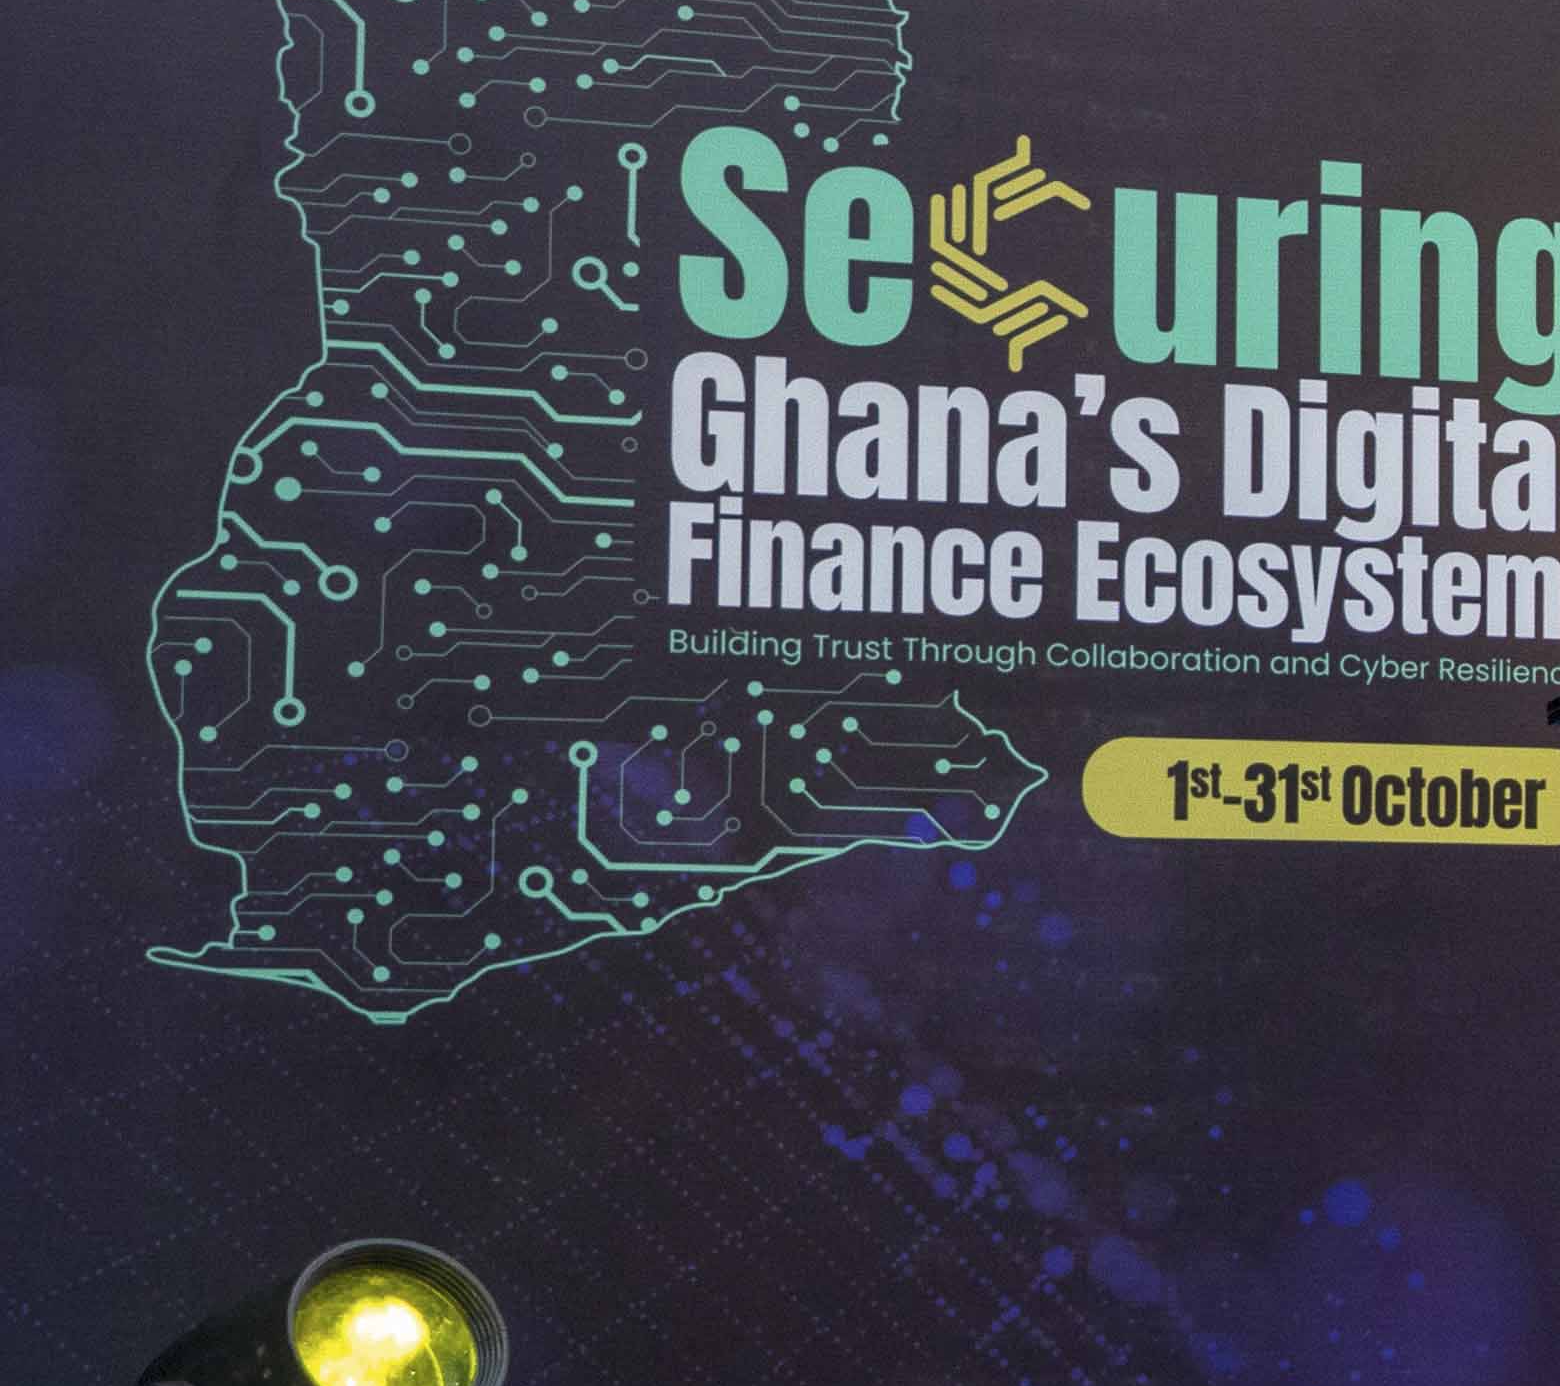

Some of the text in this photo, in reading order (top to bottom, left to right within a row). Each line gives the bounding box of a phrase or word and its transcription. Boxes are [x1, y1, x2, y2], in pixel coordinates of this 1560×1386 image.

[666, 496, 1045, 619] Finance
[668, 628, 802, 665] Building
[813, 633, 894, 661] Trust
[902, 637, 1038, 673] Through
[1046, 640, 1261, 675] Collaboration
[1269, 648, 1330, 677] and
[1339, 650, 1432, 685] Cyber
[1342, 764, 1547, 831] October
